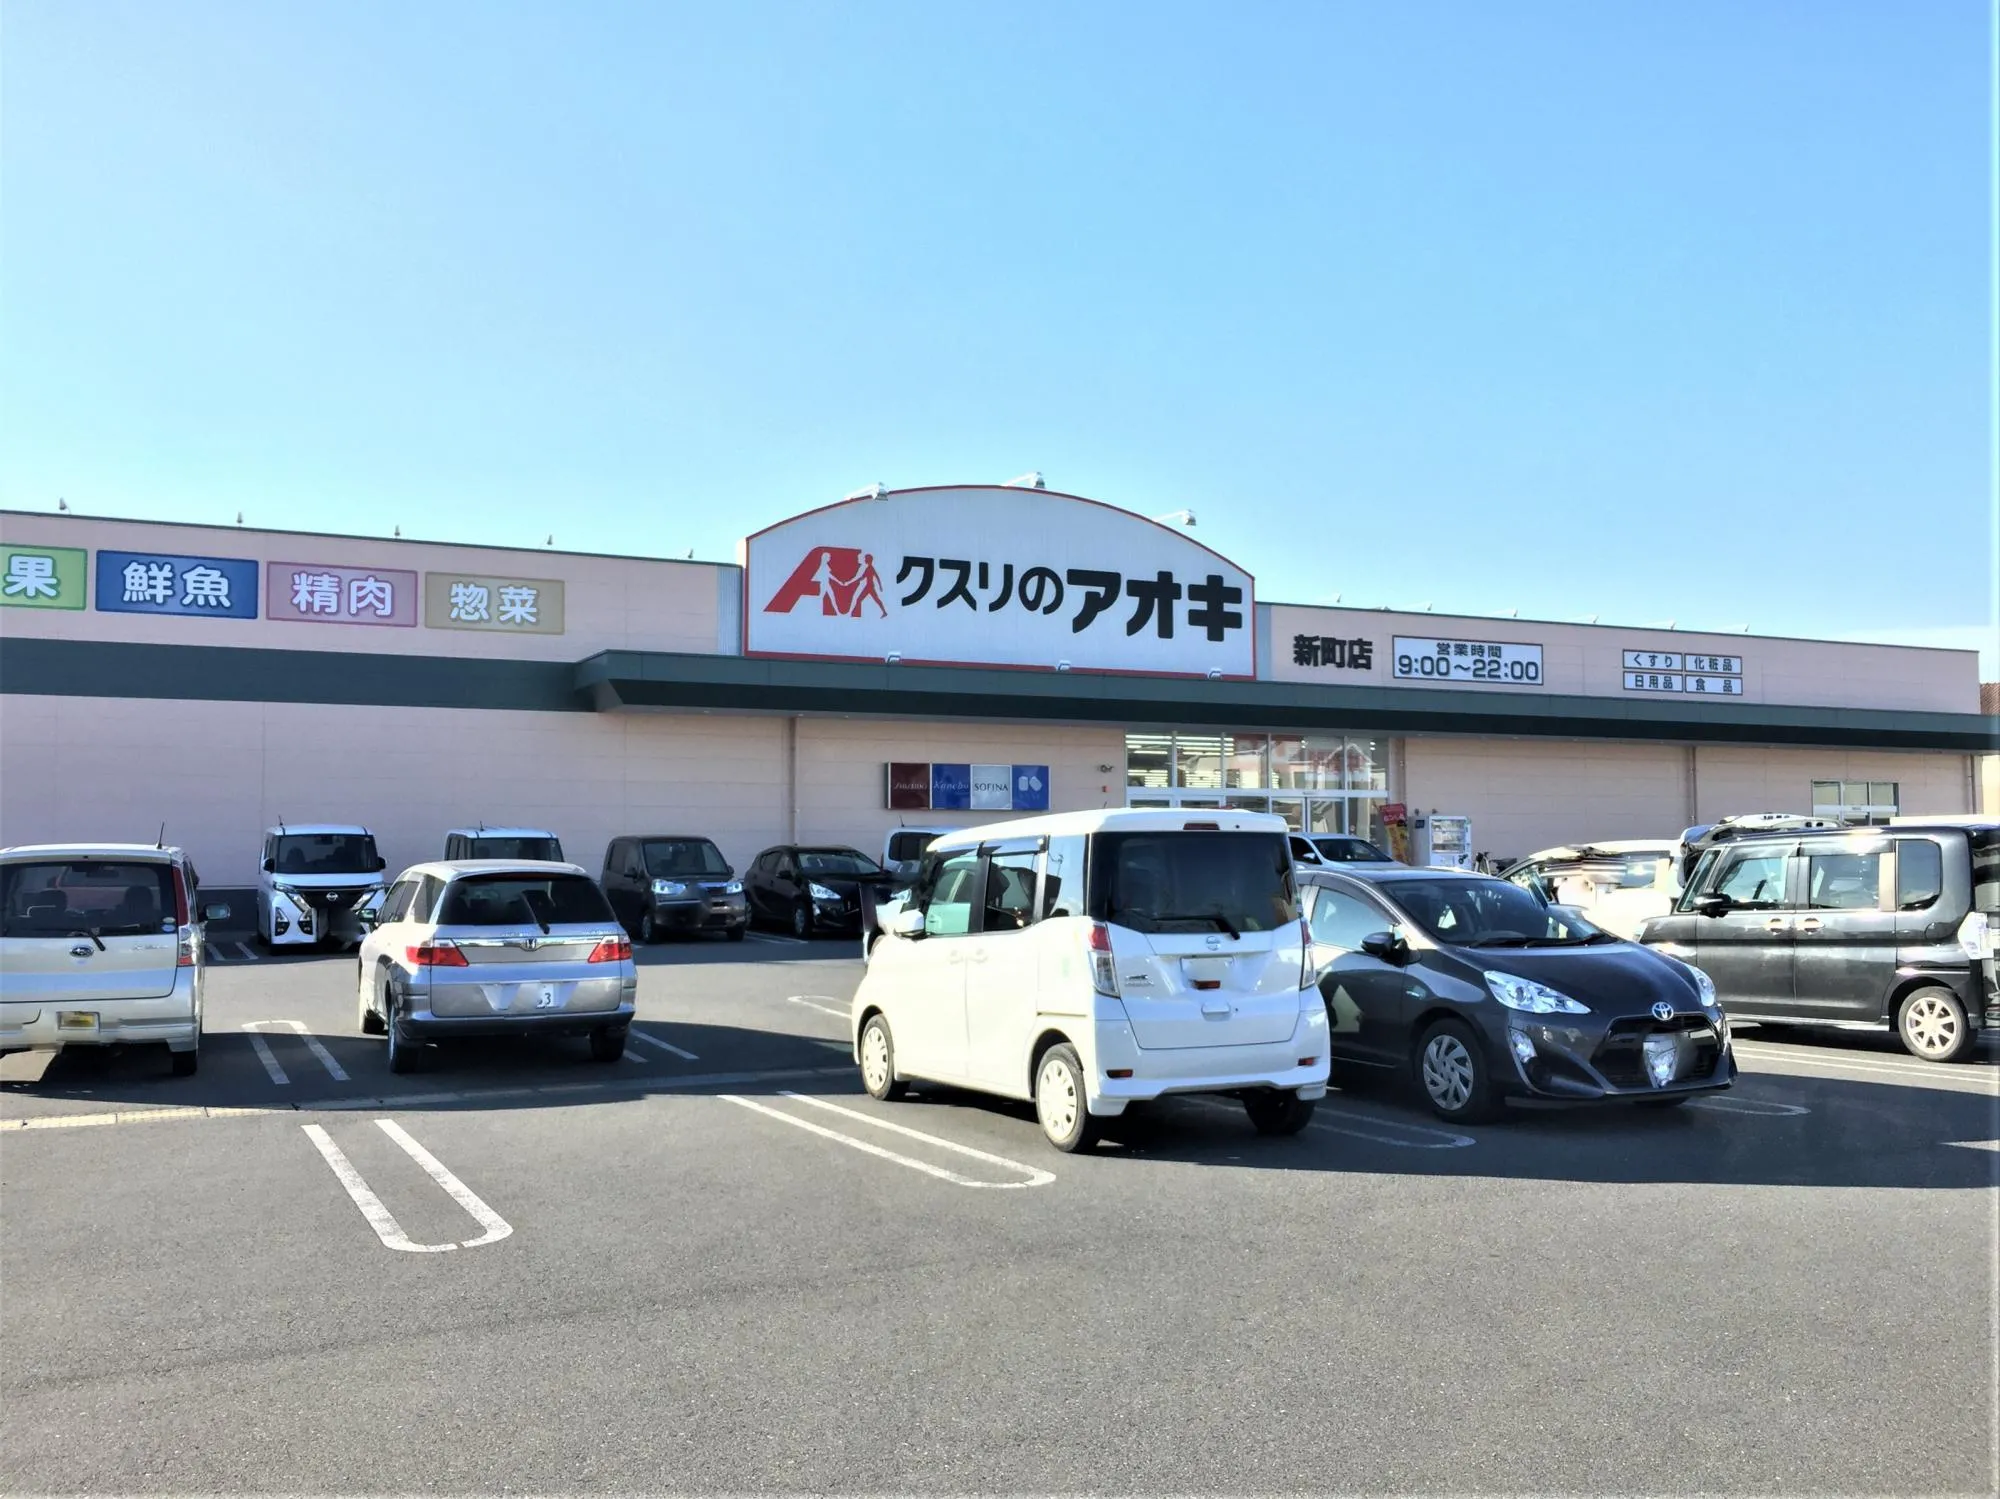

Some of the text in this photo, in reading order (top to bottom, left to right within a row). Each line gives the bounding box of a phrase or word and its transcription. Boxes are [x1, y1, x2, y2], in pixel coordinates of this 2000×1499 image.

[121, 560, 232, 608] 鮮魚
[291, 571, 394, 617] 精肉
[448, 581, 538, 625] 惣菜
[896, 555, 1243, 642] クスリのアオキ
[1293, 634, 1373, 669] 新町店
[1437, 642, 1502, 658] 営業時間
[1633, 653, 1673, 668] くすり
[1694, 657, 1732, 671] 化粧品
[1634, 674, 1674, 689] 日用品
[974, 782, 1009, 792] SOFINA
